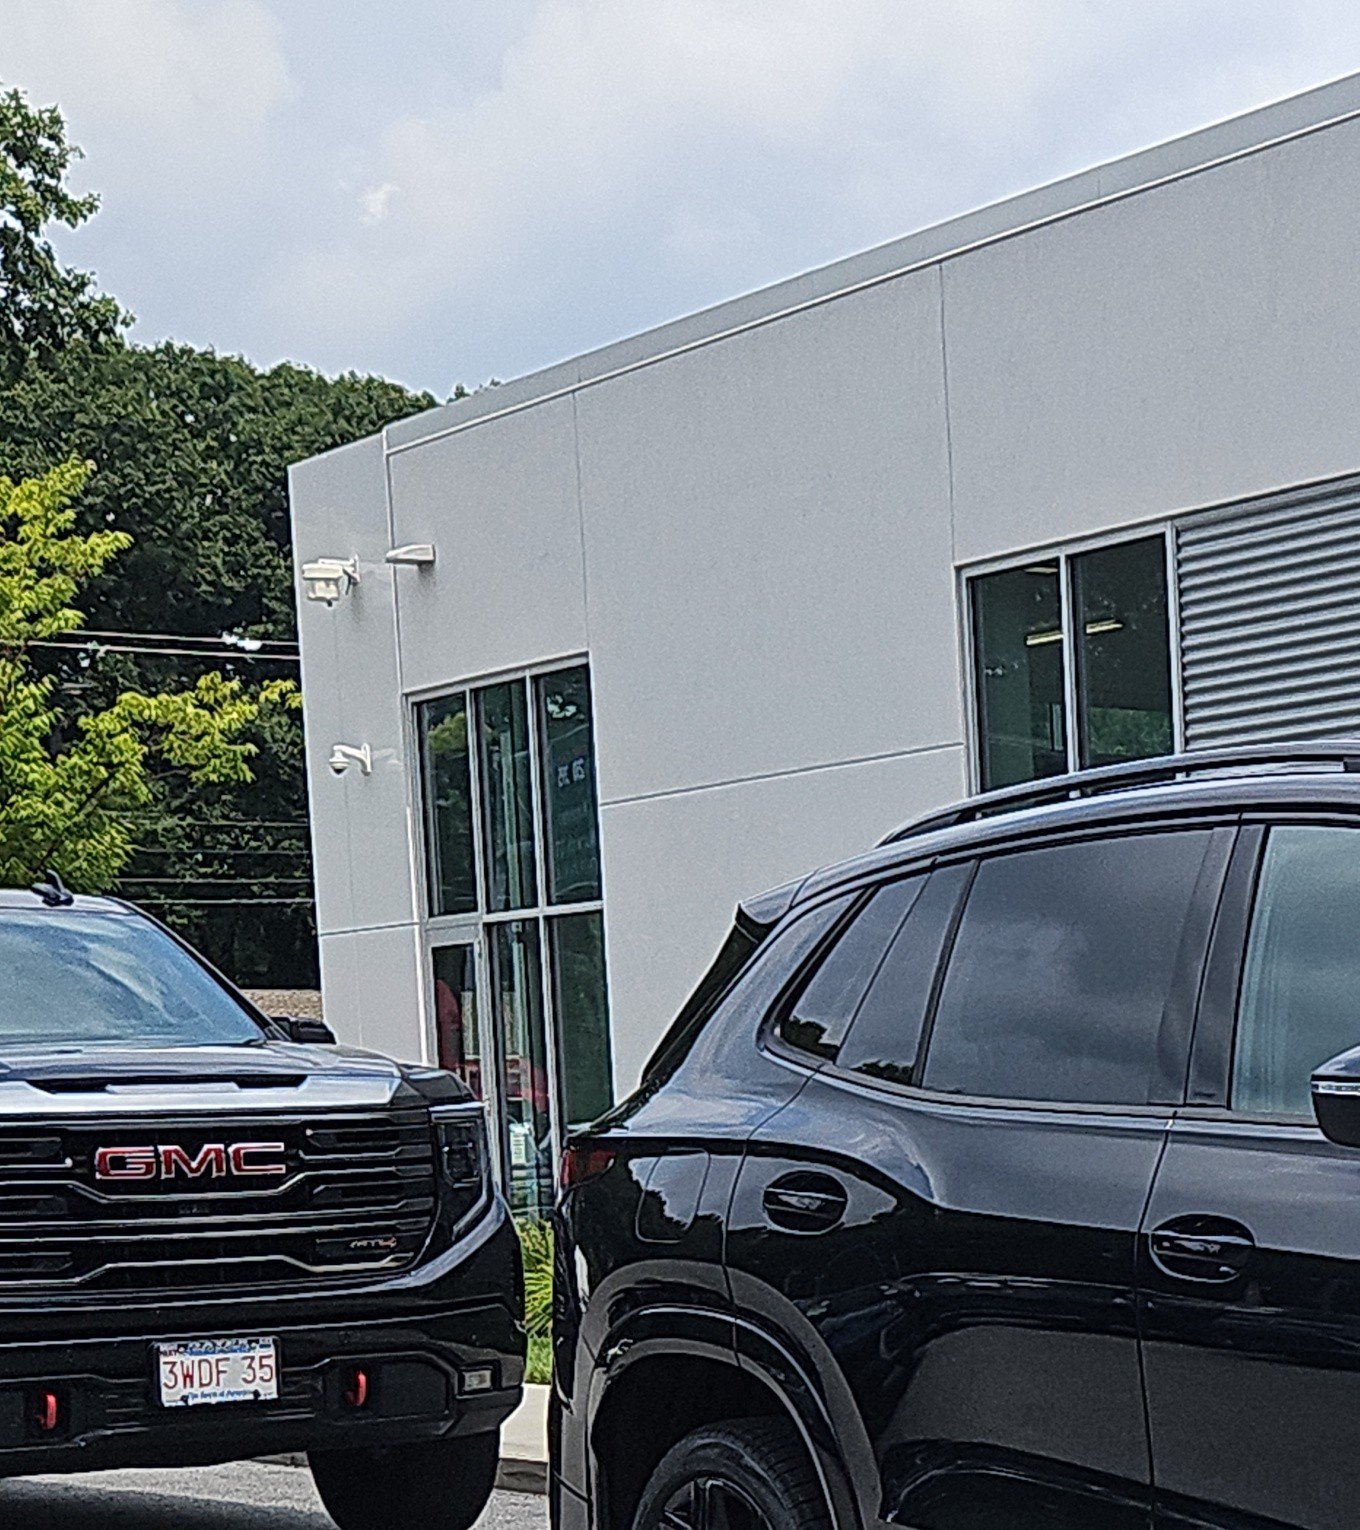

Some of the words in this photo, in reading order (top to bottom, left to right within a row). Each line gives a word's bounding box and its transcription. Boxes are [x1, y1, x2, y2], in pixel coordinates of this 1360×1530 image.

[95, 1142, 286, 1180] GMC
[162, 1357, 231, 1390] 3WDF
[241, 1354, 274, 1384] 35
